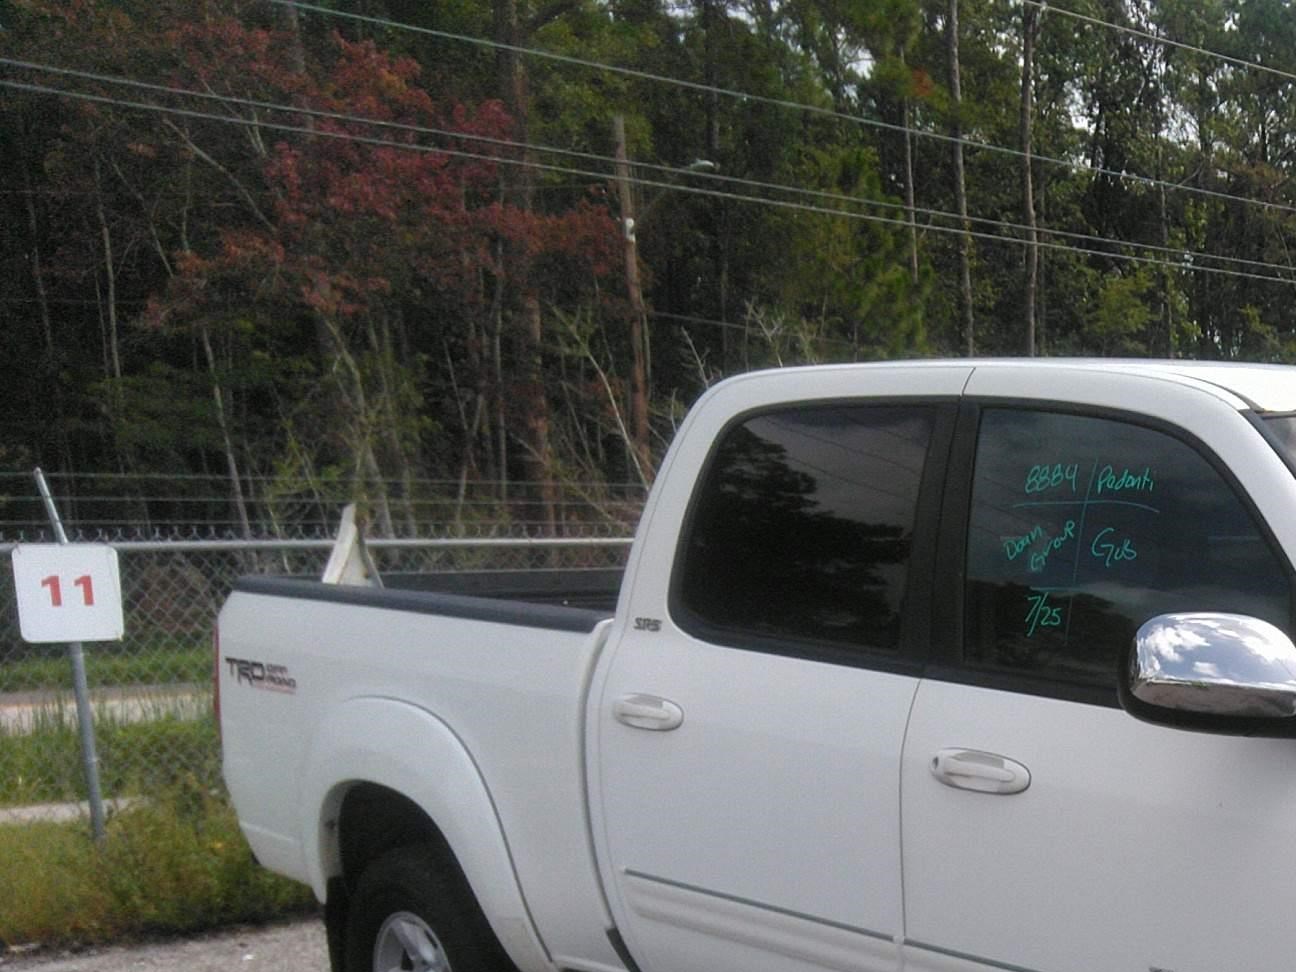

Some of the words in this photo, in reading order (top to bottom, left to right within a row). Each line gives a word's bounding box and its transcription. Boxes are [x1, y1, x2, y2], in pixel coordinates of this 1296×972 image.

[1025, 463, 1078, 494] 8884
[41, 575, 95, 607] 11
[1025, 592, 1062, 637] 7/25
[224, 656, 265, 686] TRD
